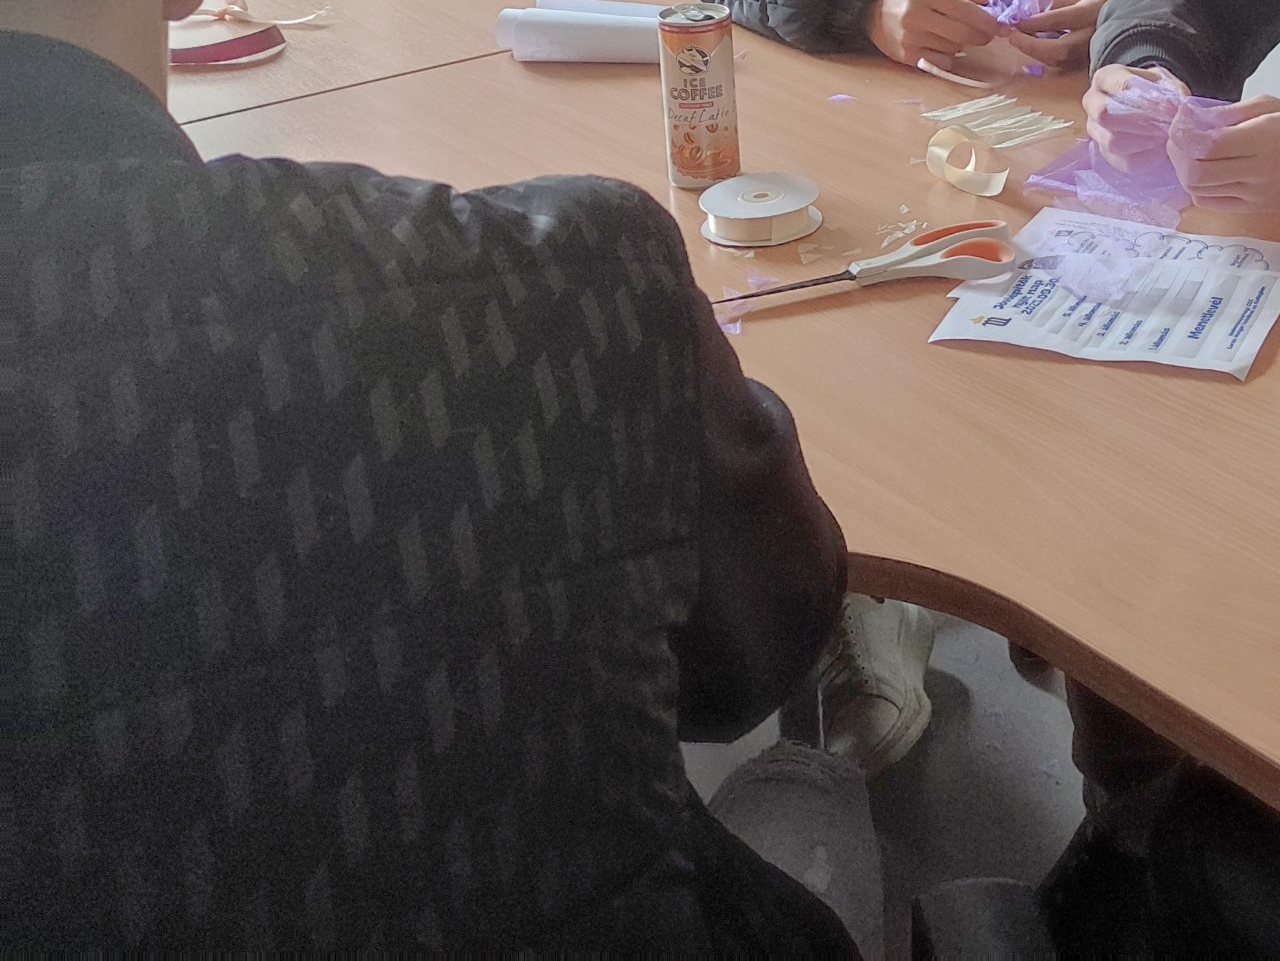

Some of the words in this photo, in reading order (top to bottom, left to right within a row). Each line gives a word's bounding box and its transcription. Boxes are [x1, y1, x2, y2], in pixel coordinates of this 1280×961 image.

[683, 77, 706, 88] ICE
[670, 84, 723, 101] COFFEE
[1026, 279, 1046, 296] nap
[1187, 296, 1224, 340] Menetlevél
